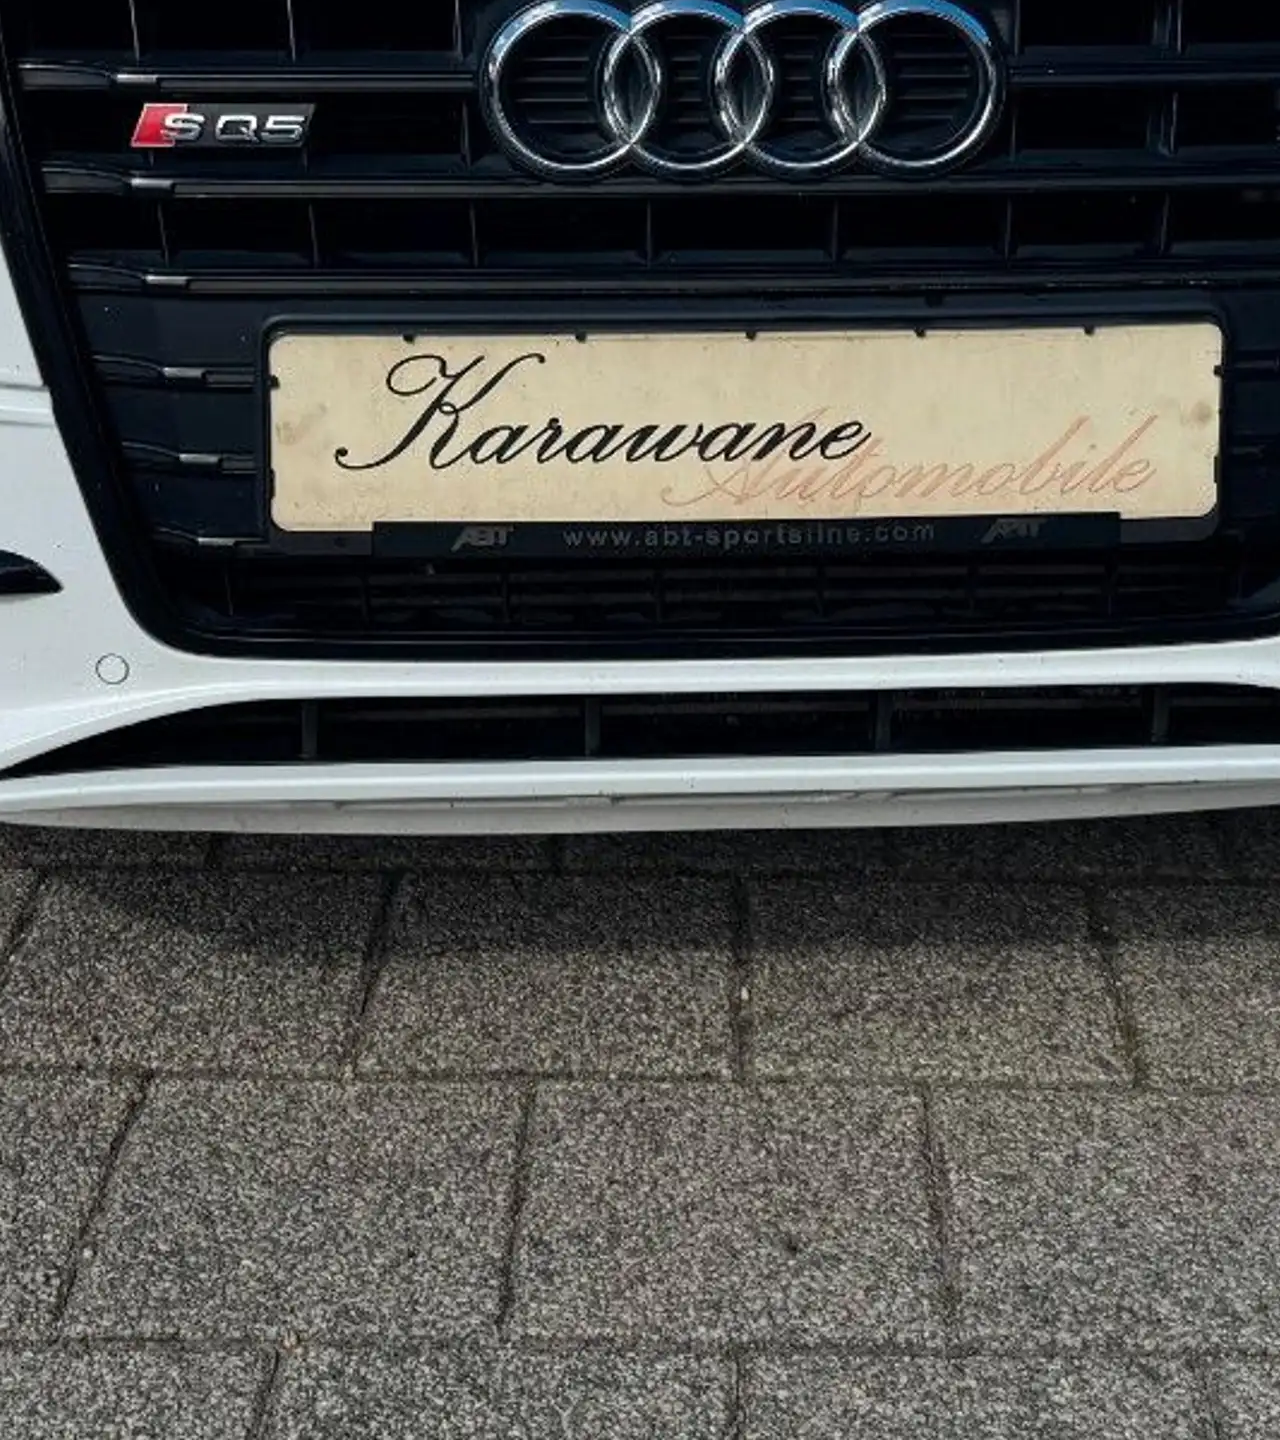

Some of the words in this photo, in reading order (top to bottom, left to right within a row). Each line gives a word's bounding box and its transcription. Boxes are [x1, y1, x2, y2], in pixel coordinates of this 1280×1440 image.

[160, 113, 305, 143] SQ5
[336, 353, 872, 470] Karawane
[661, 406, 1159, 507] Automobile
